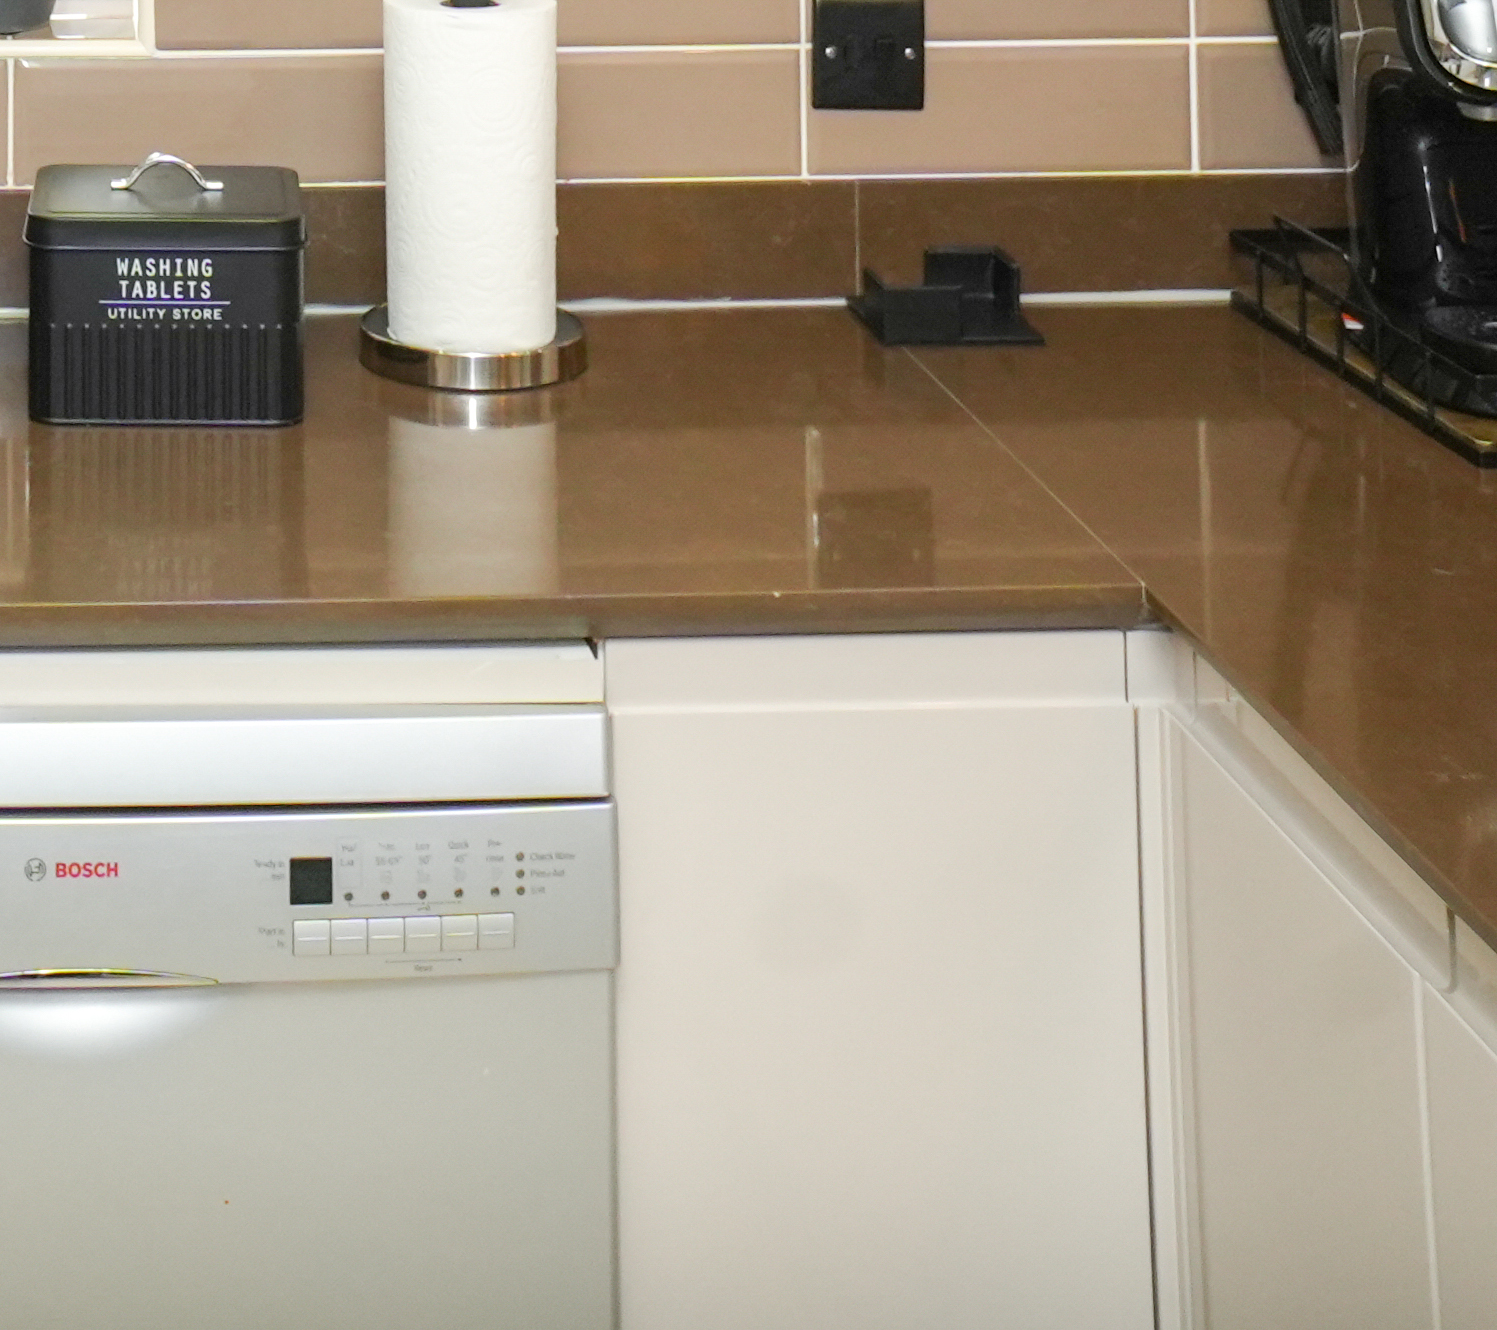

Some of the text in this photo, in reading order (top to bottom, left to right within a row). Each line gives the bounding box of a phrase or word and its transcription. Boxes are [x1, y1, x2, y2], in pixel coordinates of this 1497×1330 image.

[116, 257, 213, 277] WASHING
[118, 280, 212, 299] TABLETS
[107, 307, 223, 320] UTILITY STORE
[55, 862, 119, 878] BOSCH
